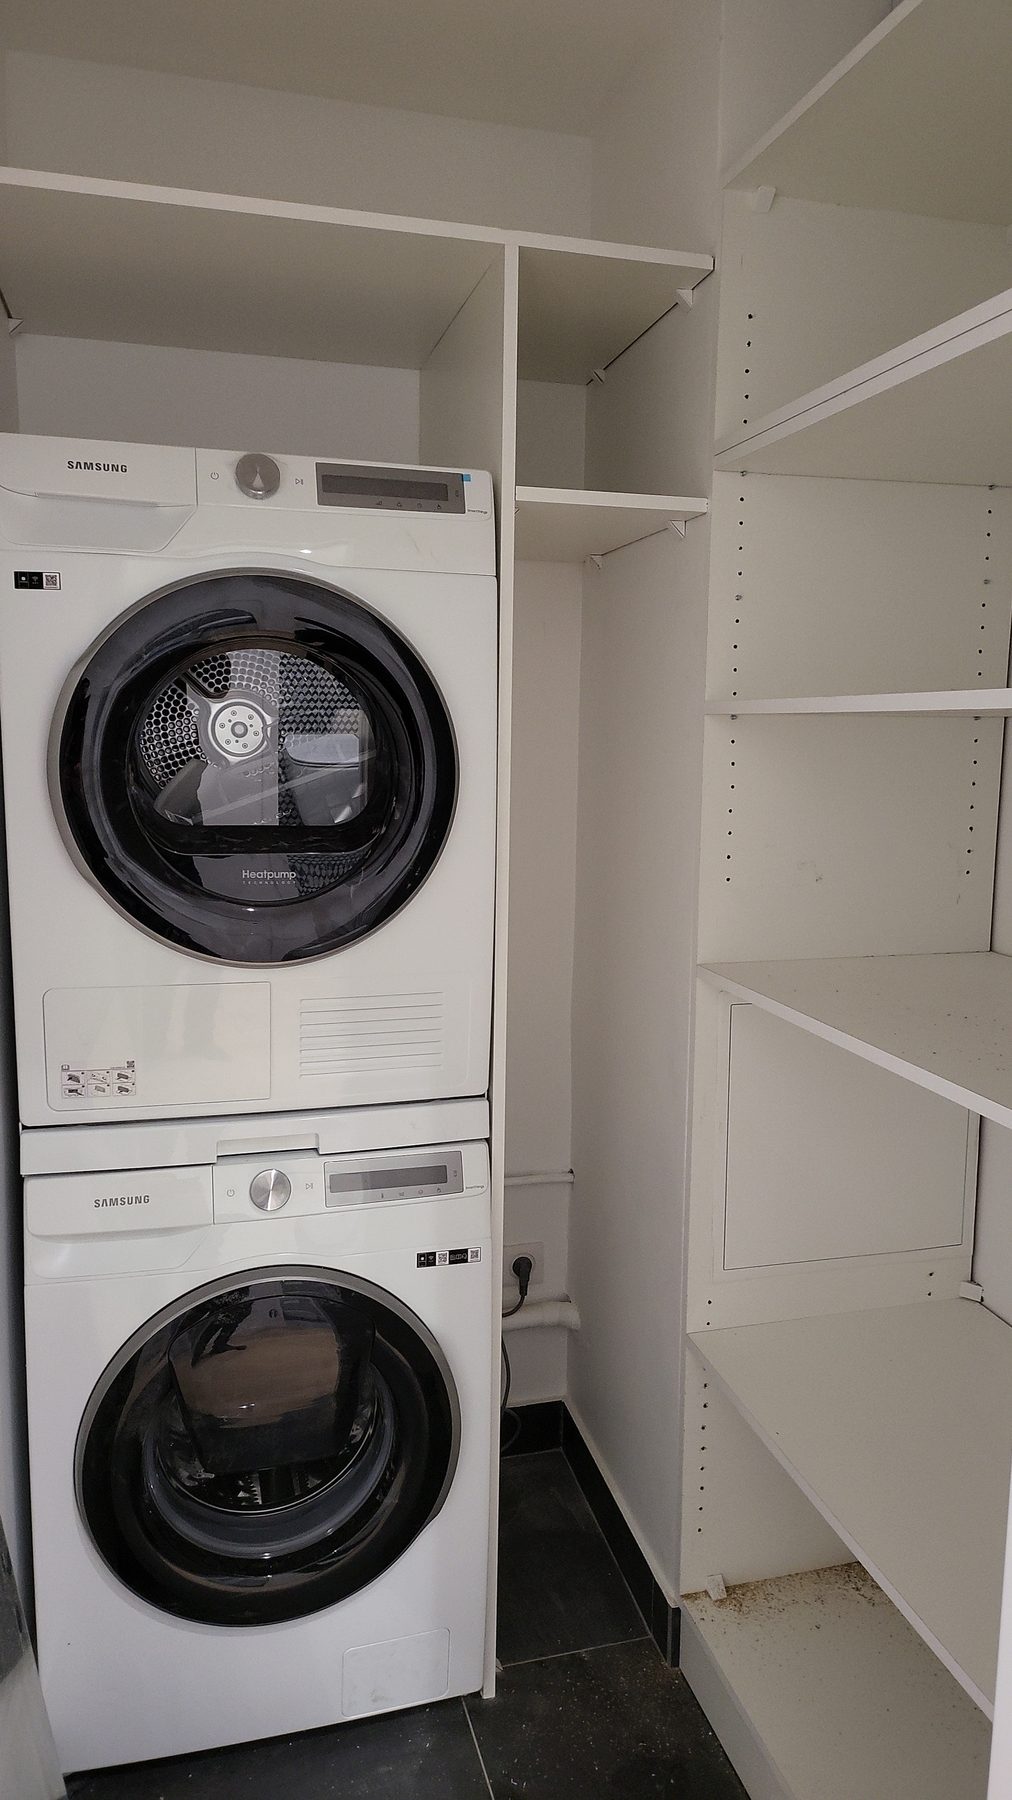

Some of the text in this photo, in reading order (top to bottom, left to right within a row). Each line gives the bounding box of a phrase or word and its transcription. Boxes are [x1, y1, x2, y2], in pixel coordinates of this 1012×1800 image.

[67, 460, 128, 473] SAMSUNG
[242, 869, 297, 880] Heatpump
[93, 1194, 150, 1208] SAMSUNG
